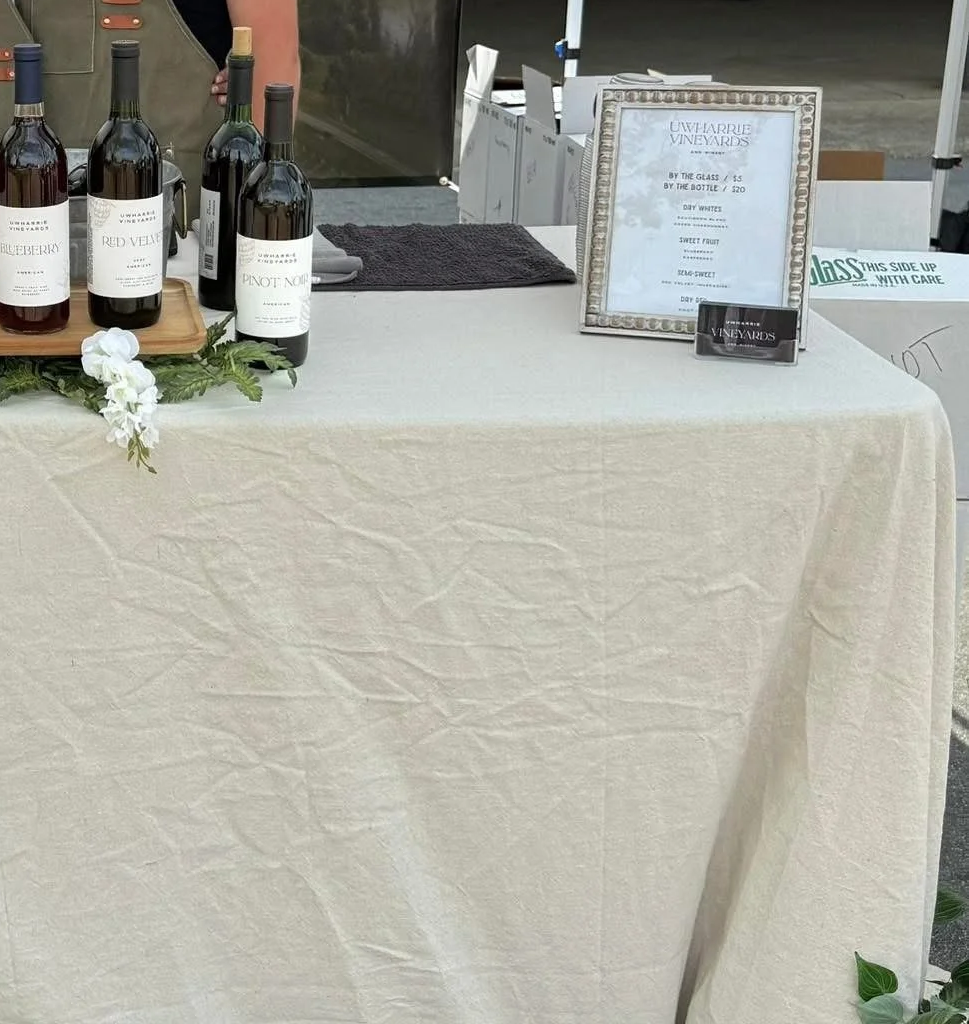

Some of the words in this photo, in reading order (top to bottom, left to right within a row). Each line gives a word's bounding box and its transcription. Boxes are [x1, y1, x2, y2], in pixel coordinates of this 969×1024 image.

[670, 121, 751, 135] UWHARRIE
[670, 134, 750, 147] VINEYARDS
[681, 172, 694, 180] THE
[696, 173, 719, 181] GLASS
[733, 175, 743, 183] $5
[663, 182, 674, 190] BY
[691, 184, 718, 192] BOTTLE
[732, 185, 746, 193] $20
[698, 205, 722, 213] WHITES
[102, 236, 126, 248] RED
[702, 238, 720, 246] FRUIT
[0, 242, 62, 256] BLUEBERRY
[810, 254, 865, 286] lass
[858, 261, 888, 272] THIS
[890, 262, 920, 272] SIDE
[920, 262, 938, 273] UP
[677, 269, 716, 278] SEMI-SWEET
[875, 274, 910, 285] WITH
[911, 275, 945, 285] CARE
[242, 273, 281, 289] PINOT
[711, 327, 776, 341] VINEYARDS
